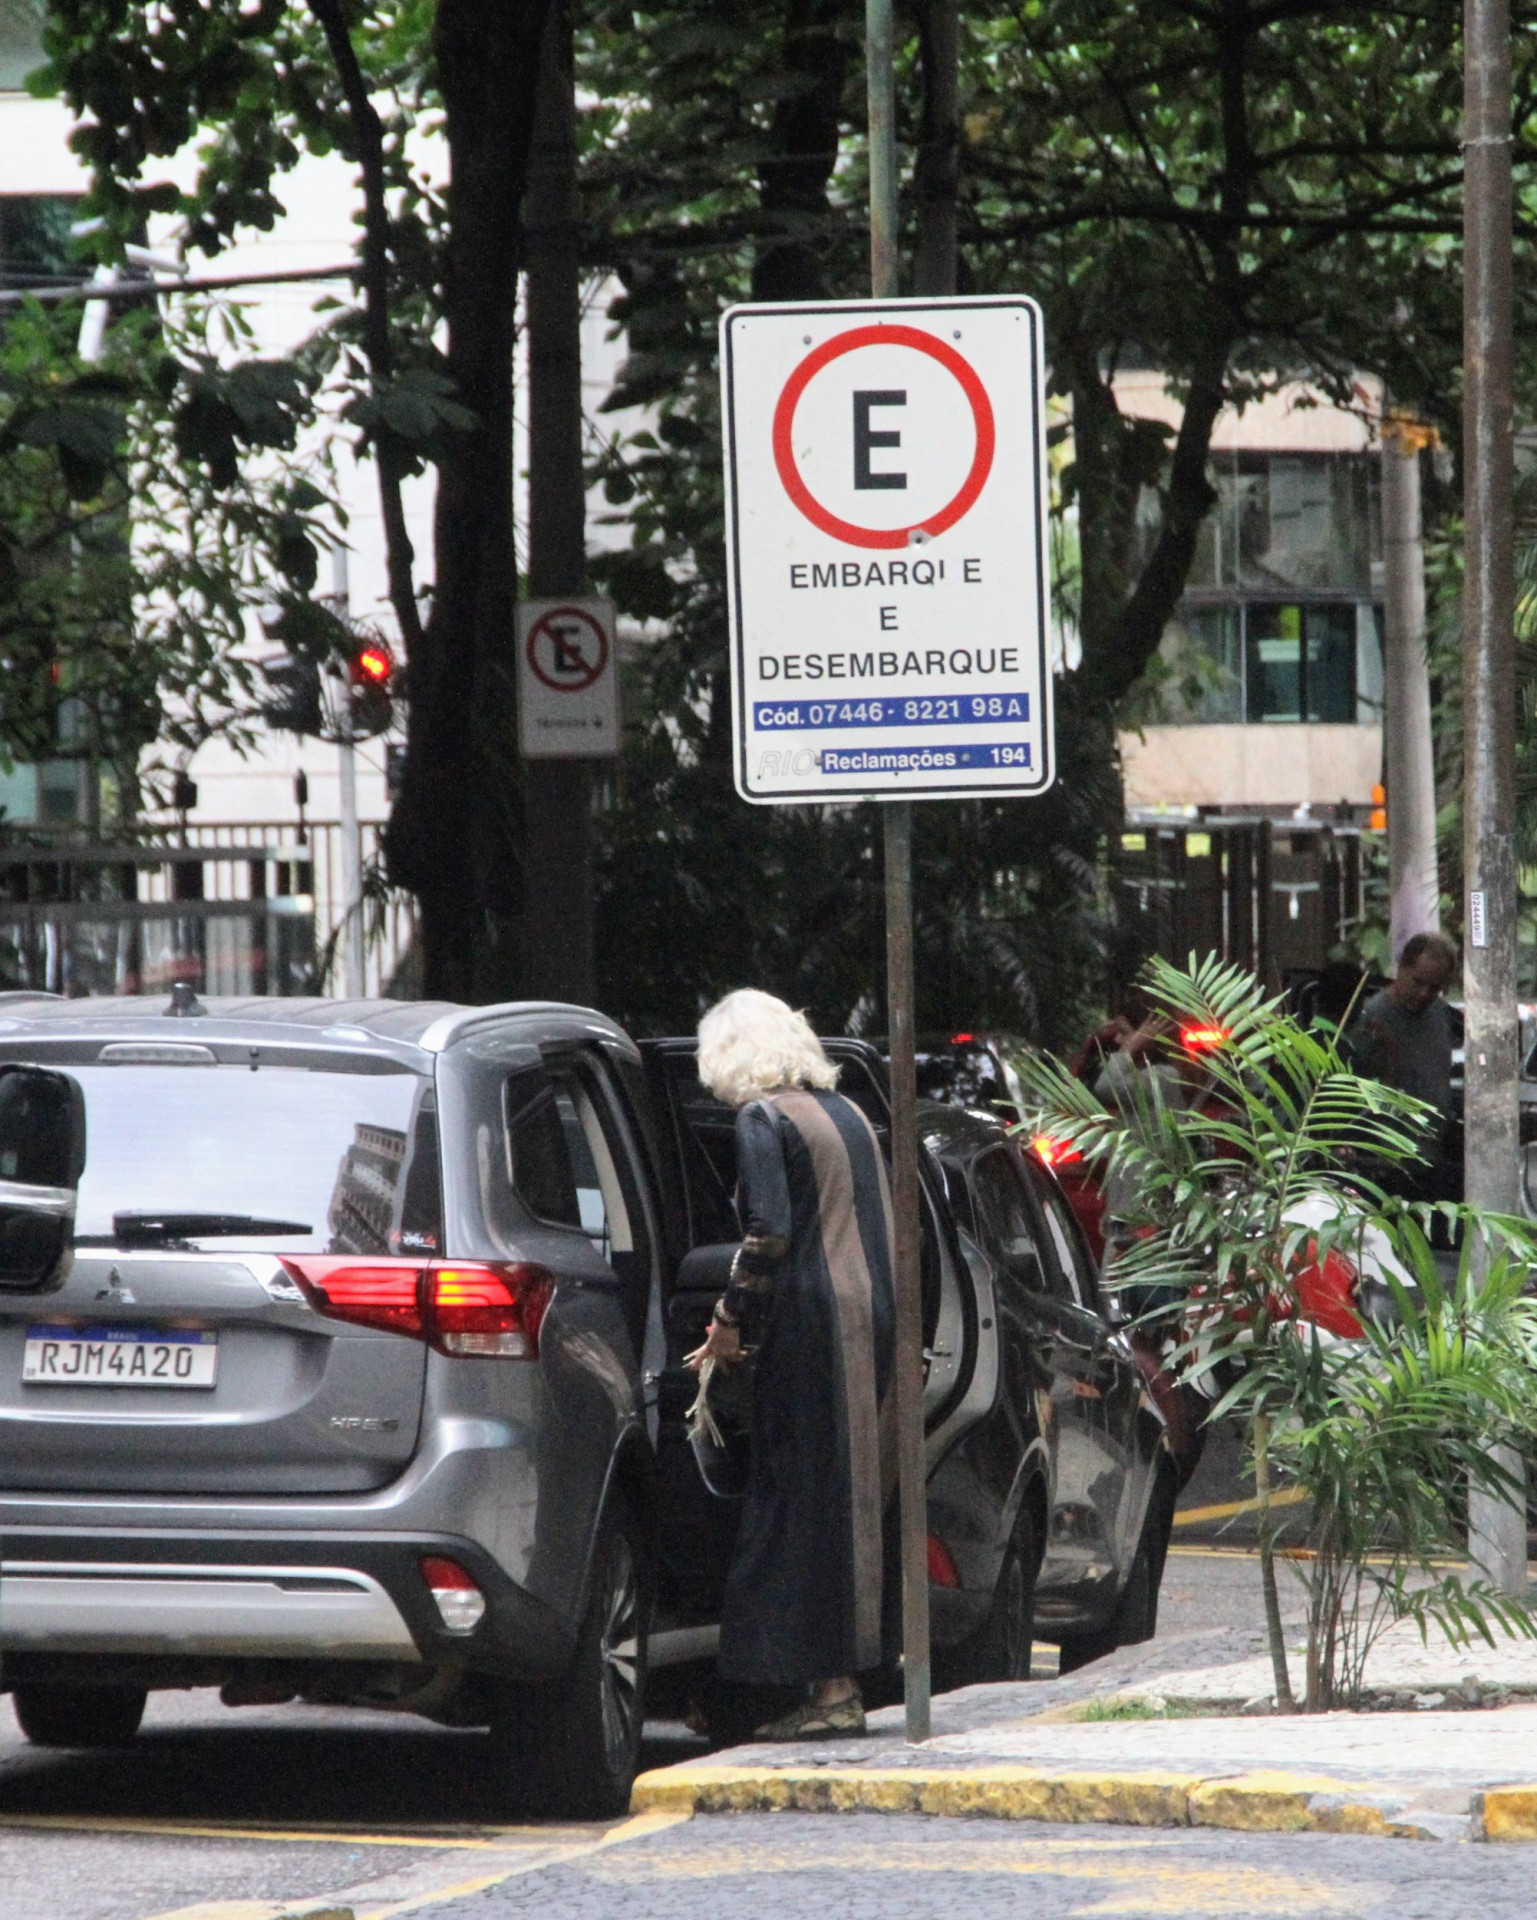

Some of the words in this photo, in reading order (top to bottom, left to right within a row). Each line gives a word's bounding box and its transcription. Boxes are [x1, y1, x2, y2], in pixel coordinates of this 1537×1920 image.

[853, 389, 907, 490] E
[879, 605, 899, 631] E
[758, 648, 1019, 681] DESEMBARQUE
[758, 706, 805, 726] Cód.
[904, 700, 960, 720] 8221
[759, 748, 816, 777] RIO
[824, 749, 957, 772] Reclamações
[990, 746, 1026, 764] 194
[1472, 893, 1481, 931] 024449
[39, 1342, 193, 1378] RJM4A20
